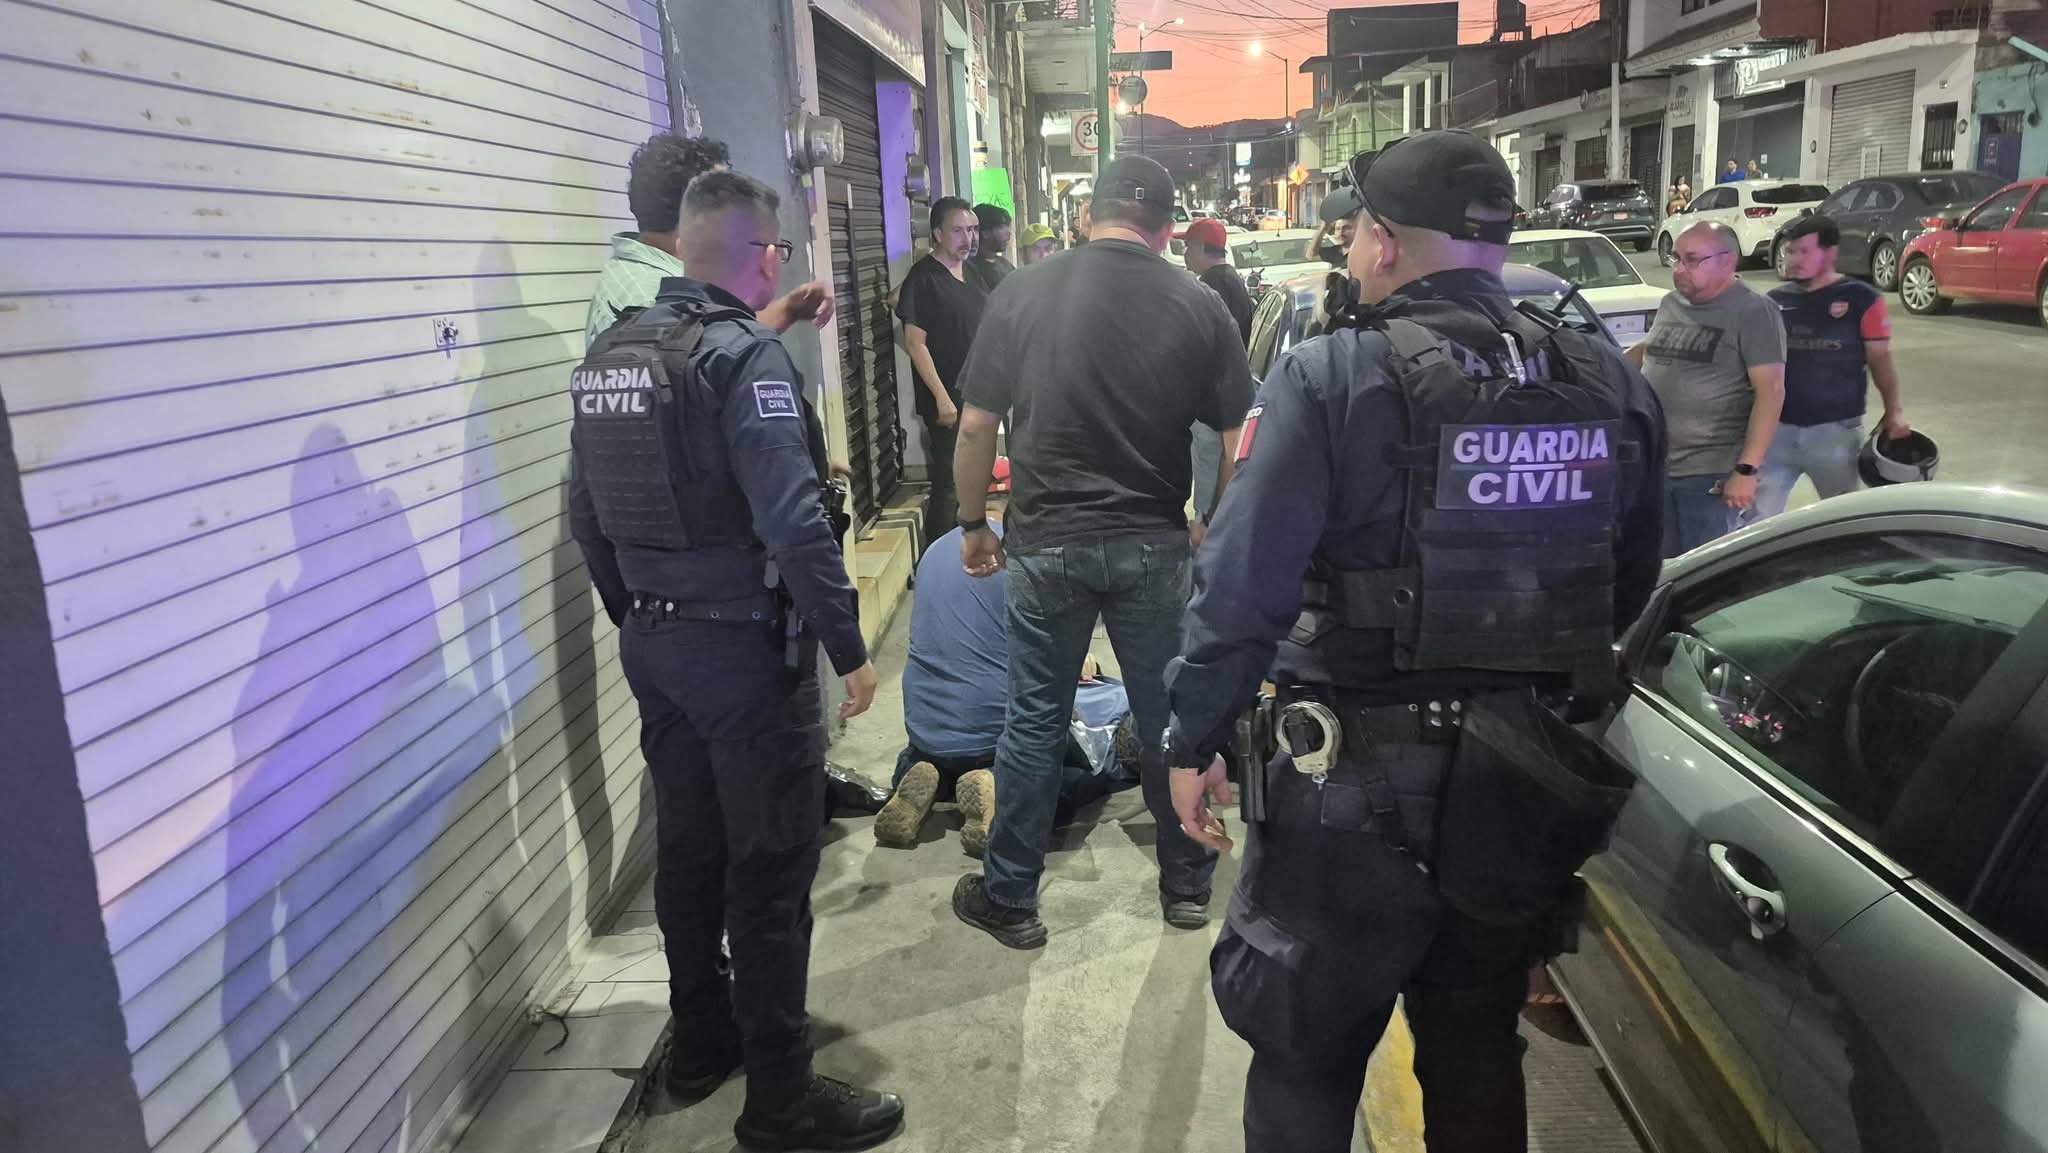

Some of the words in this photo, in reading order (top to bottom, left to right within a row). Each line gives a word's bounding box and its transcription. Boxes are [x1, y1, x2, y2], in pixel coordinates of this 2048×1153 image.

[572, 366, 653, 391] GUARDIA
[581, 392, 646, 414] CIVIL
[760, 389, 791, 399] GUARDIA
[768, 399, 788, 409] CIVIL
[1453, 428, 1609, 464] GUARDIA
[1468, 470, 1593, 504] CIVIL
